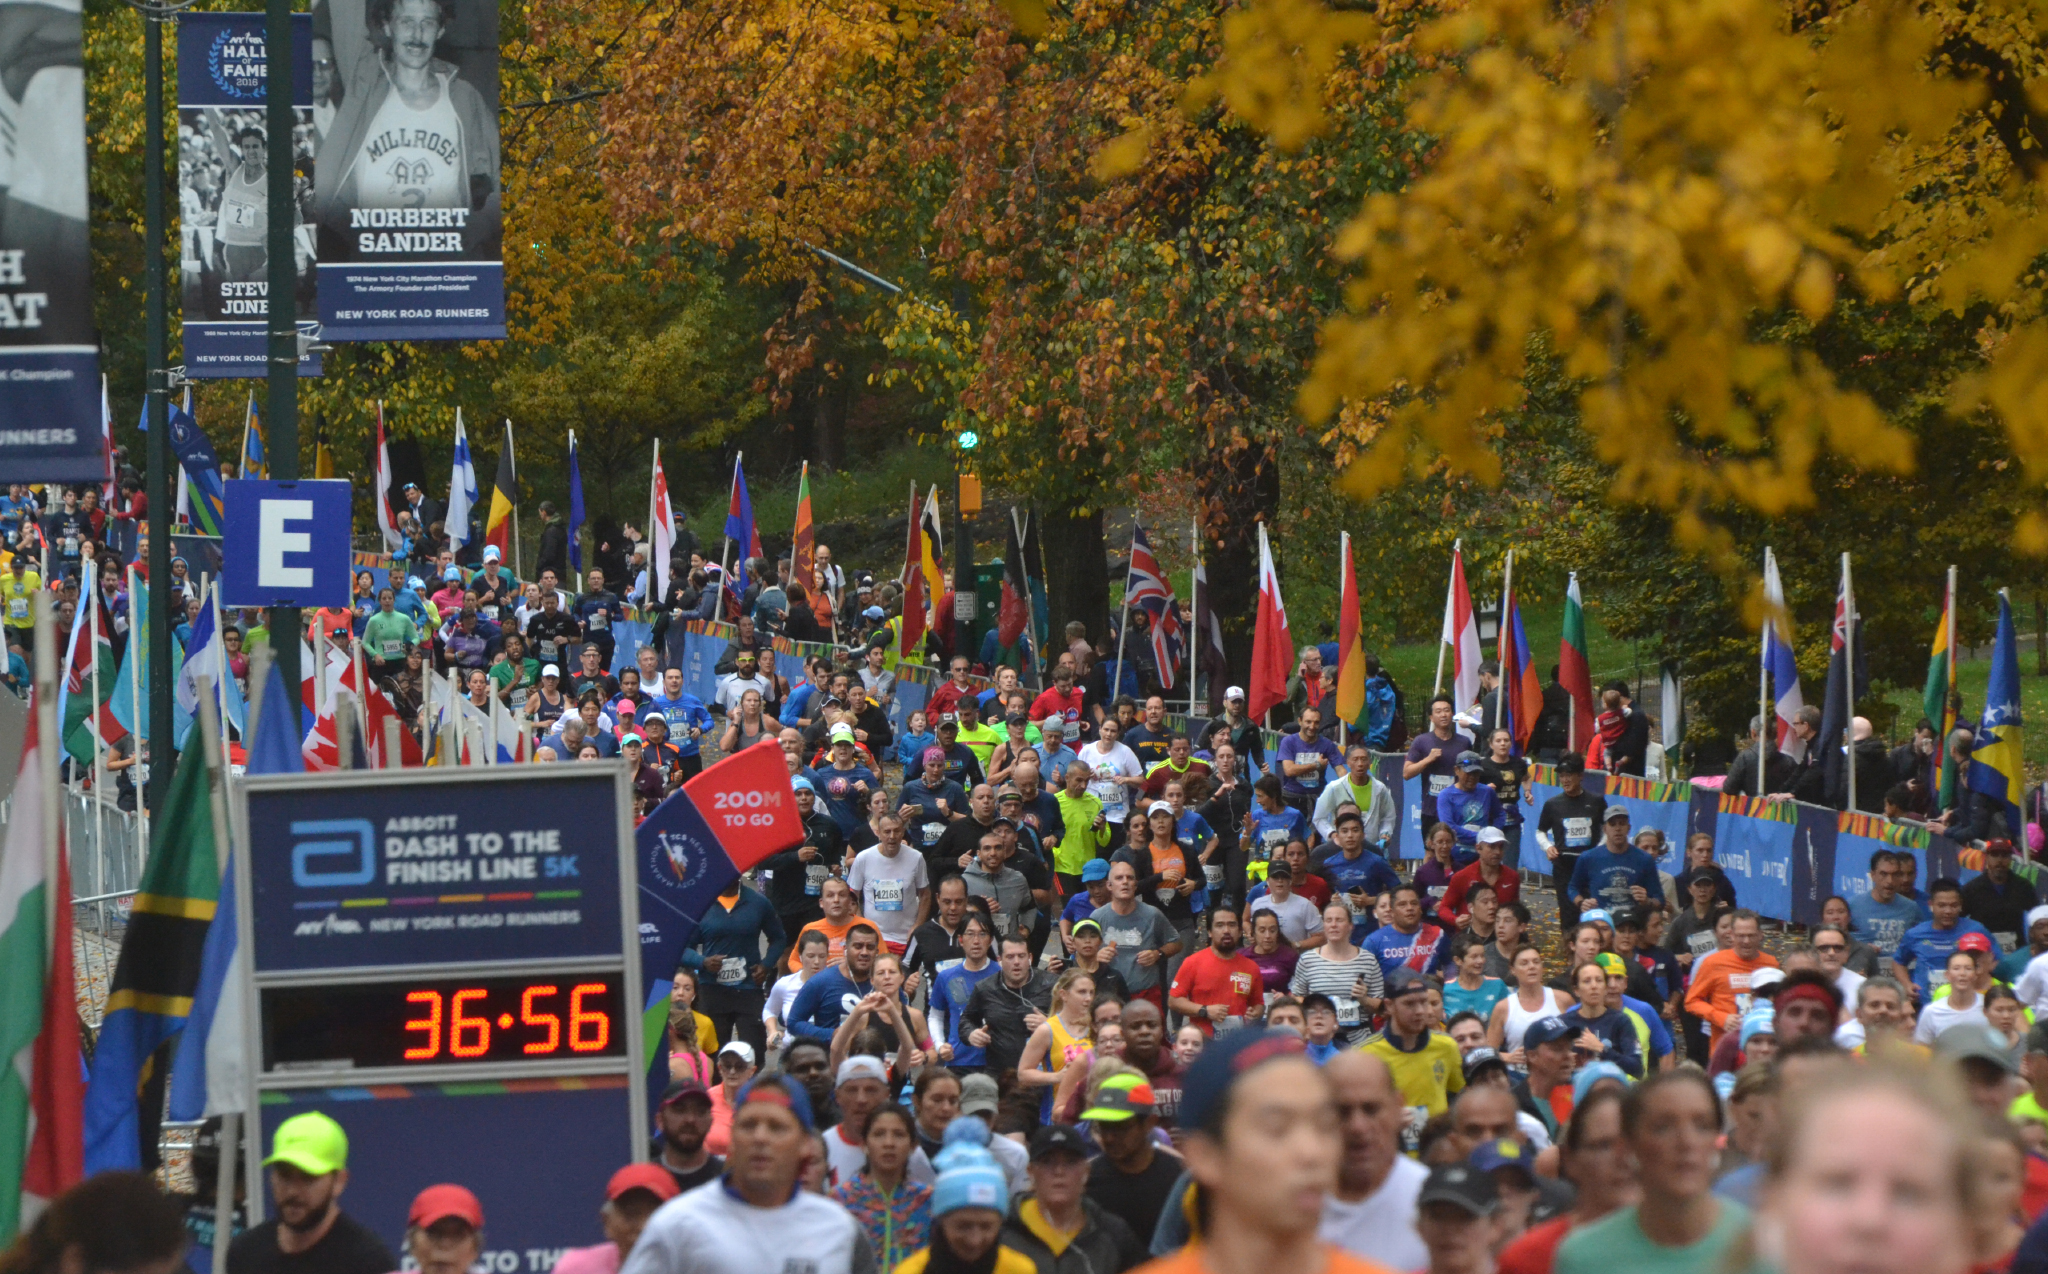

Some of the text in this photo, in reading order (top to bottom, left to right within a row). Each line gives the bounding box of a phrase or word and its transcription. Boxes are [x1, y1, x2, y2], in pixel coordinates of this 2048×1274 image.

[223, 45, 267, 58] HALL
[223, 64, 268, 77] FAME
[236, 78, 258, 86] 2016
[366, 128, 458, 166] MILLROSE
[236, 208, 242, 224] 2
[350, 208, 470, 228] NORBERT
[359, 232, 463, 253] SANDER
[0, 249, 26, 285] H
[396, 276, 409, 284] City
[443, 275, 477, 283] Champion
[221, 282, 269, 296] STEV
[368, 285, 394, 293] Armory
[0, 293, 48, 328] AT
[221, 299, 269, 314] JONE
[336, 309, 490, 319] NEW YORK ROAD RUNNERS
[241, 330, 252, 338] City
[10, 368, 74, 382] Champion
[0, 427, 78, 446] NNERS
[258, 499, 314, 588] E
[714, 790, 782, 809] 200M
[1099, 792, 1120, 803] 11629
[385, 815, 459, 833] ABBOTT
[723, 813, 774, 827] TO GO
[385, 829, 561, 859] DASH TO THE
[669, 833, 687, 841] TCS
[689, 837, 706, 855] NEW
[386, 854, 581, 886] FINISH LINE 5K
[650, 844, 674, 887] MARATHON
[695, 857, 708, 879] YORK
[118, 895, 135, 905] NAT
[370, 917, 409, 933] NEW
[412, 915, 456, 931] YORK
[457, 913, 504, 929] ROAD
[506, 910, 581, 927] RUNNERS
[1868, 918, 1906, 931] TYPE
[1383, 945, 1438, 959] COSTA RICA
[1338, 1008, 1354, 1019] 064
[1154, 1088, 1172, 1105] SITY
[481, 1247, 570, 1273] TO TH
